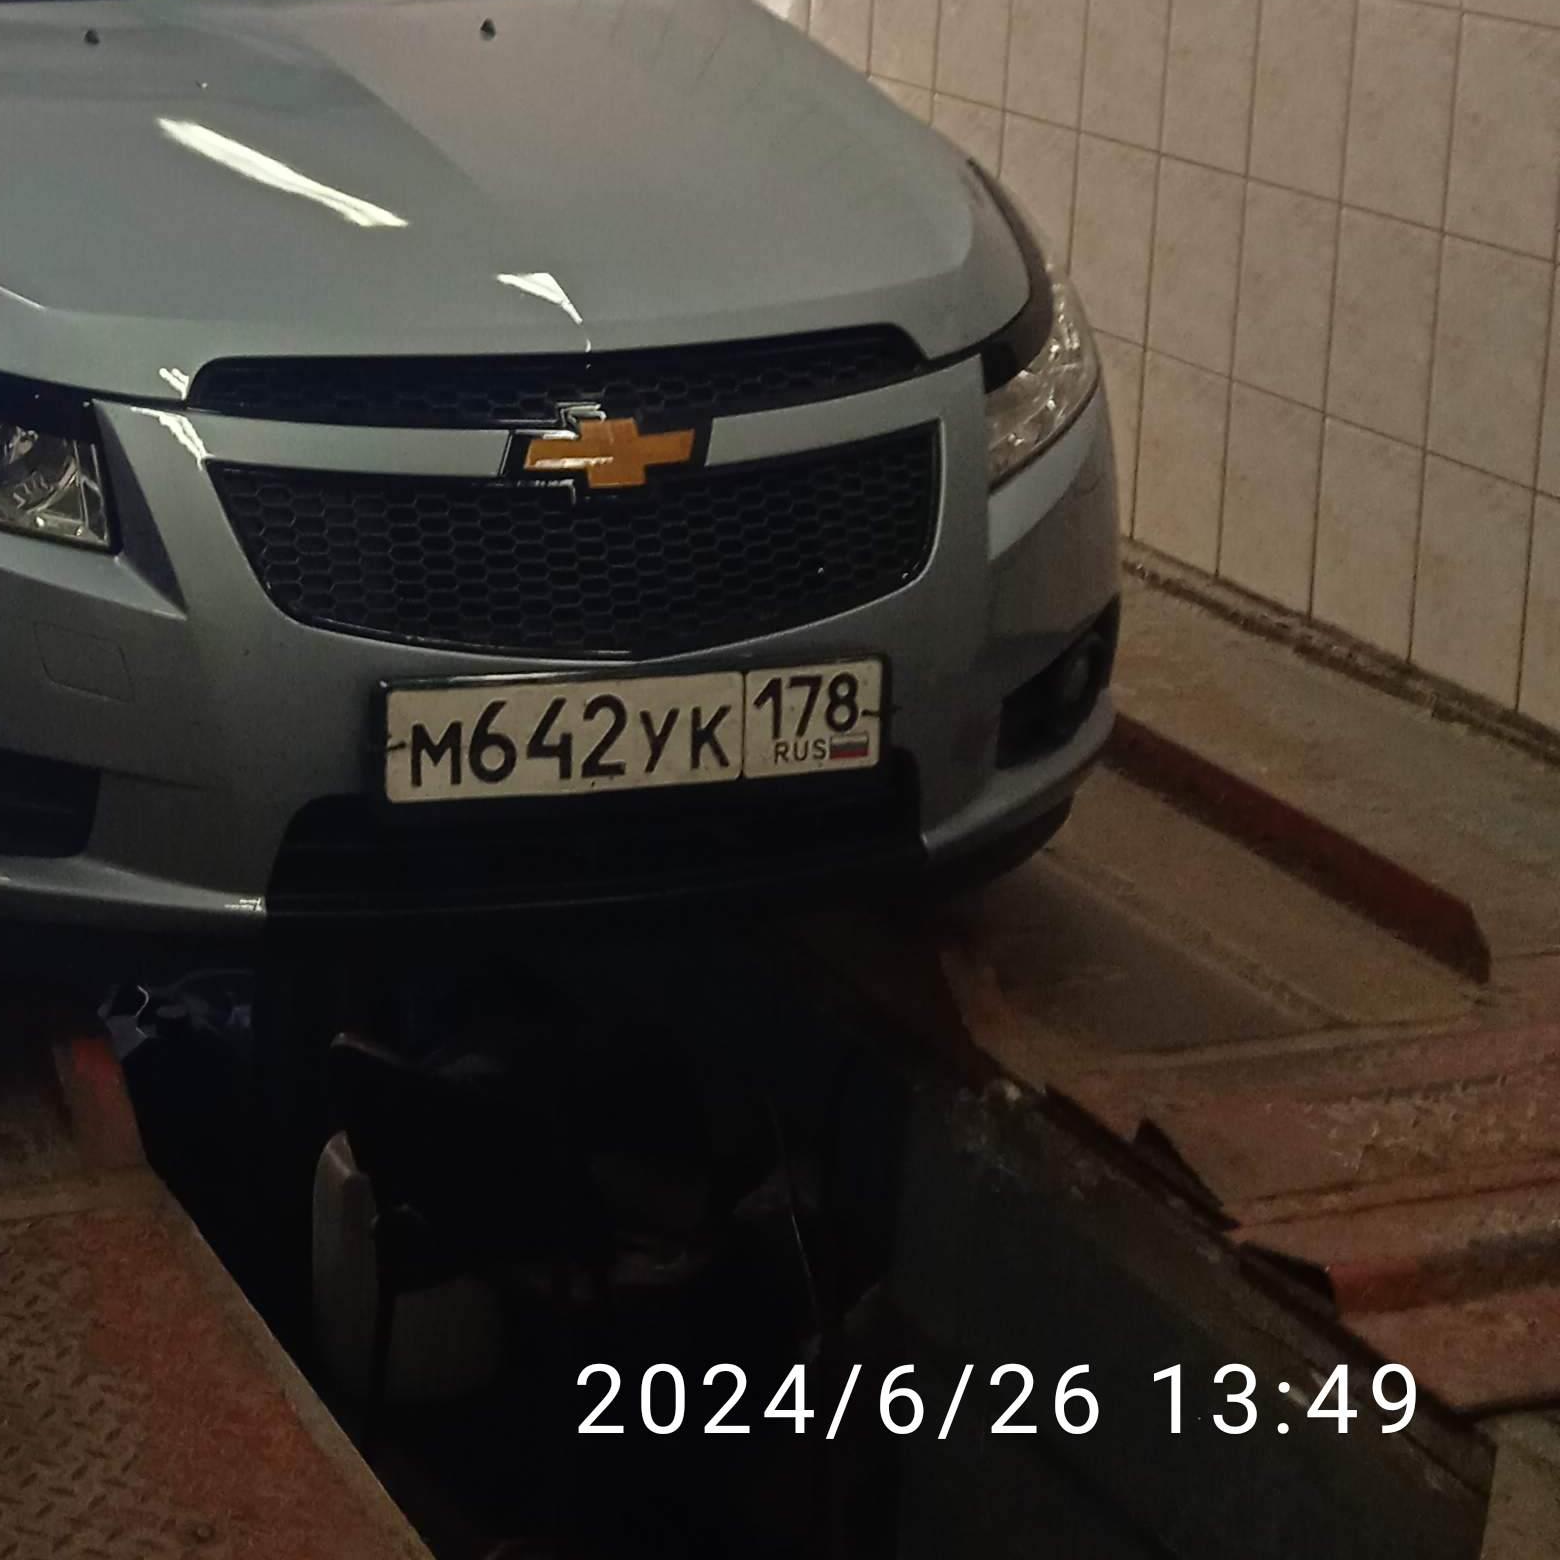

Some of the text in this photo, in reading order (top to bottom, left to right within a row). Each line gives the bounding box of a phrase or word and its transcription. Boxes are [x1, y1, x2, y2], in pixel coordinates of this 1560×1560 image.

[408, 671, 859, 788] М642УК 178
[773, 737, 827, 765] RUS
